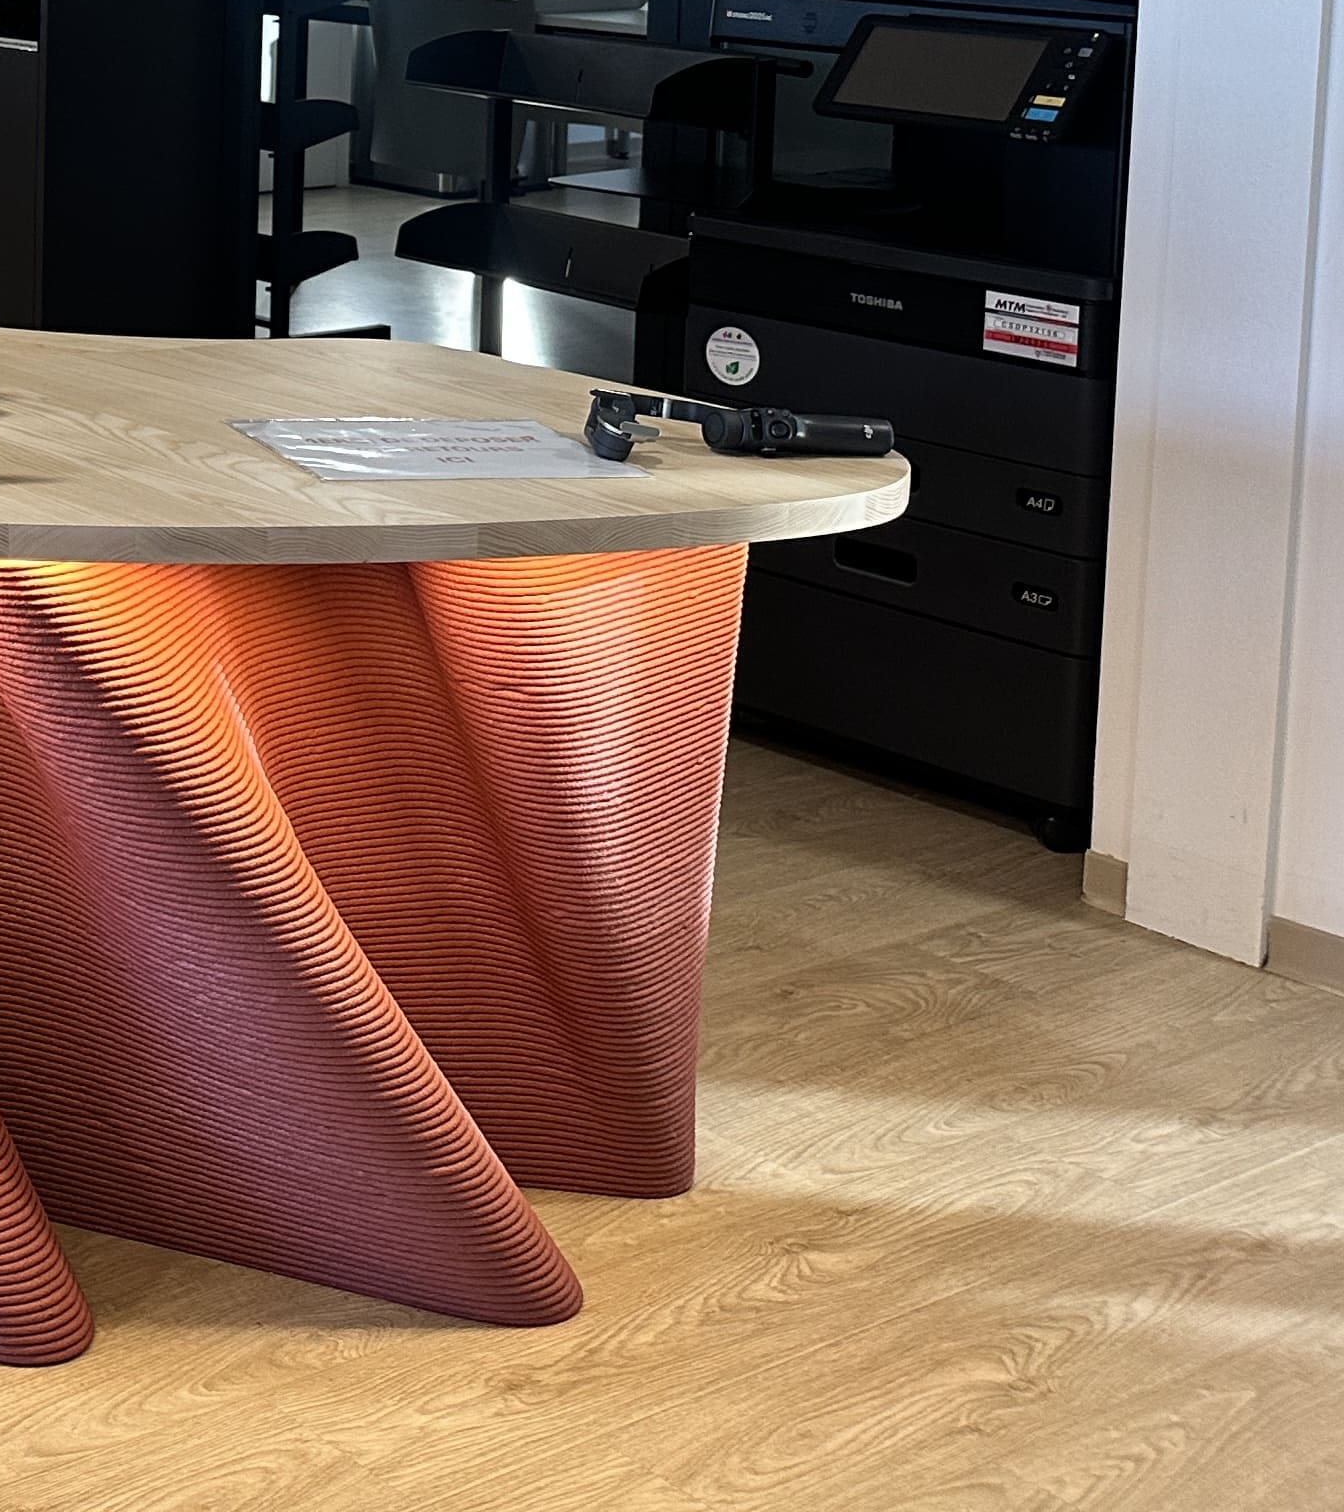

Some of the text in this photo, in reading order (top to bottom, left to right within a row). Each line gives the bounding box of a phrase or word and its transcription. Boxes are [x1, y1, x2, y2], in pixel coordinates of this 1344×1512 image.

[850, 292, 903, 311] TOSHIBA
[995, 298, 1026, 313] MTM
[1026, 496, 1043, 508] A4
[1021, 590, 1038, 603] A3
